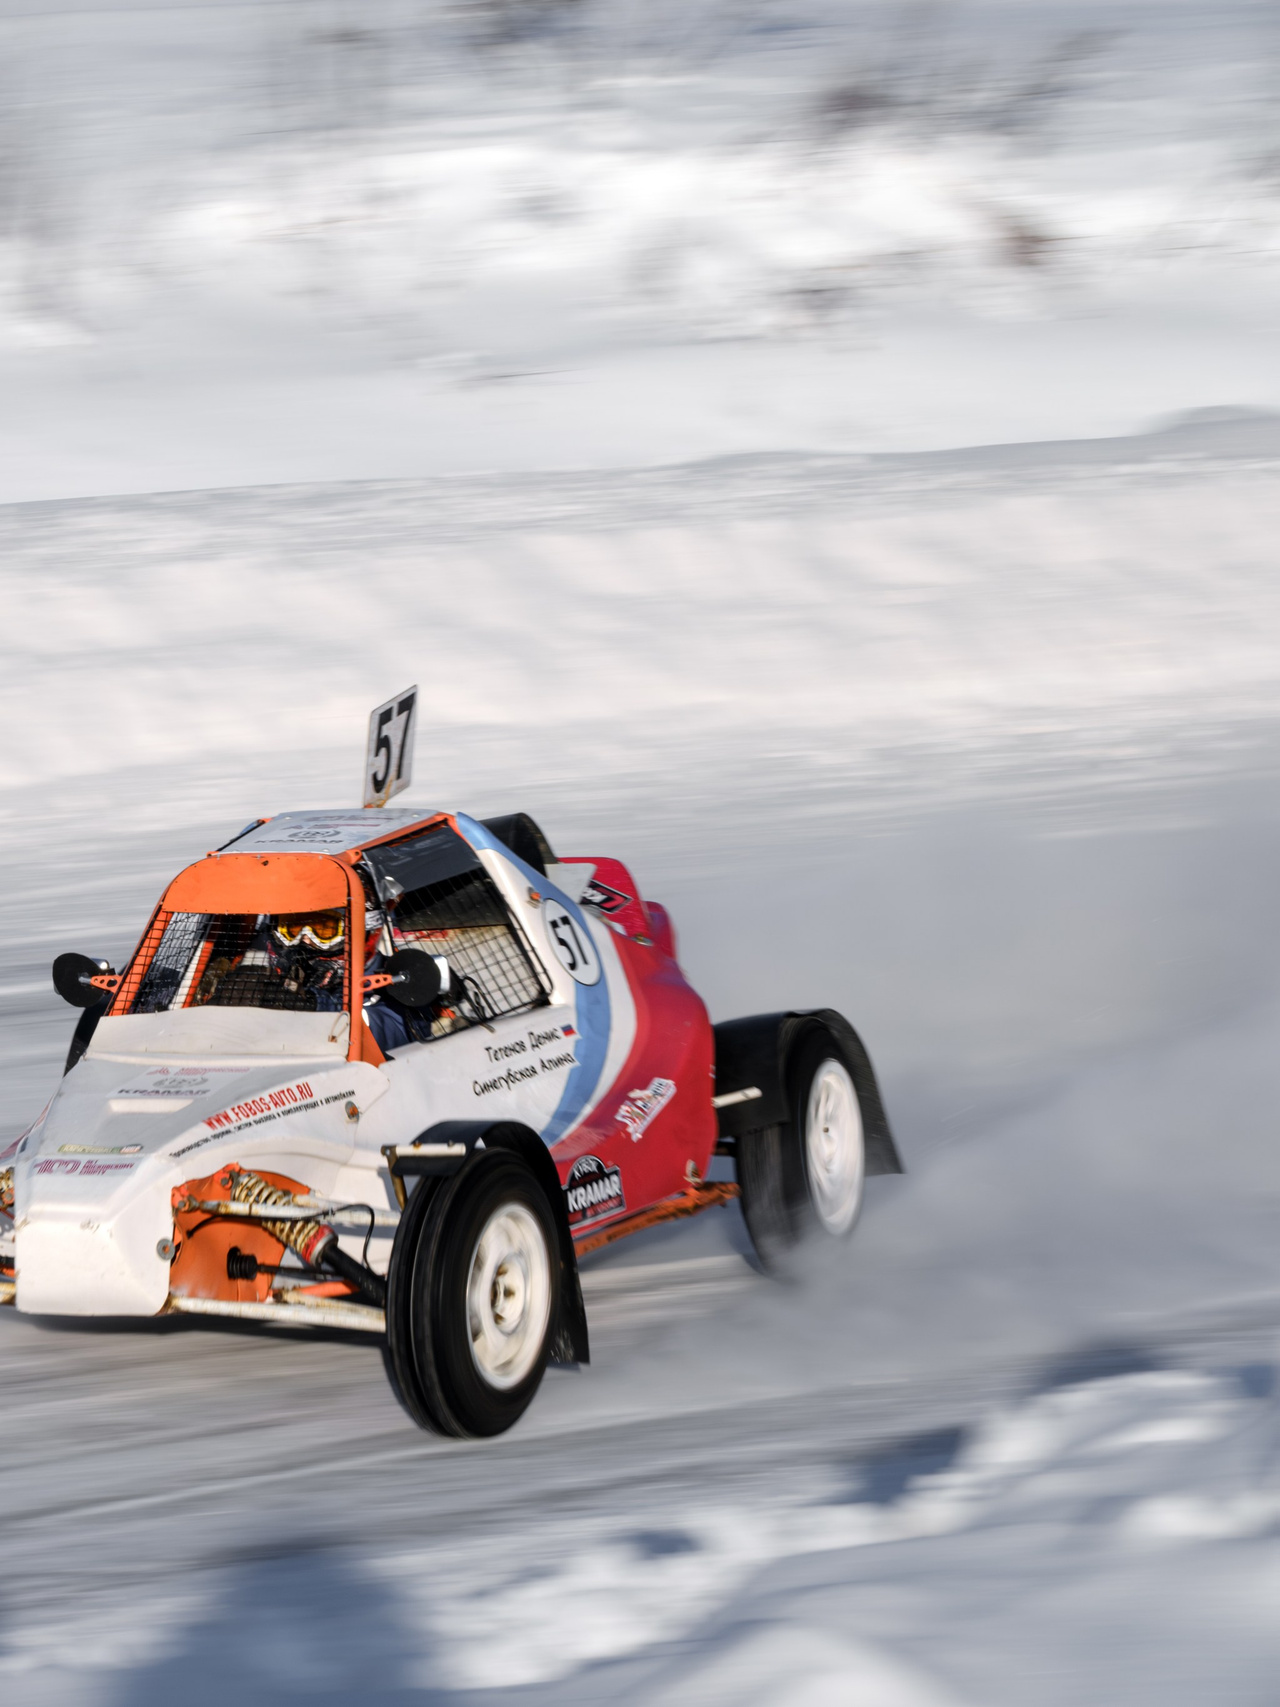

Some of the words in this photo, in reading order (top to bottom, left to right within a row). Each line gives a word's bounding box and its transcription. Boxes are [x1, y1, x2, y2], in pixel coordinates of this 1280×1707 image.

[371, 691, 416, 794] 57
[549, 915, 589, 972] 57
[202, 1081, 314, 1131] WWW.FOBOS-AVTO.RU
[567, 1174, 622, 1213] KRAMAR
